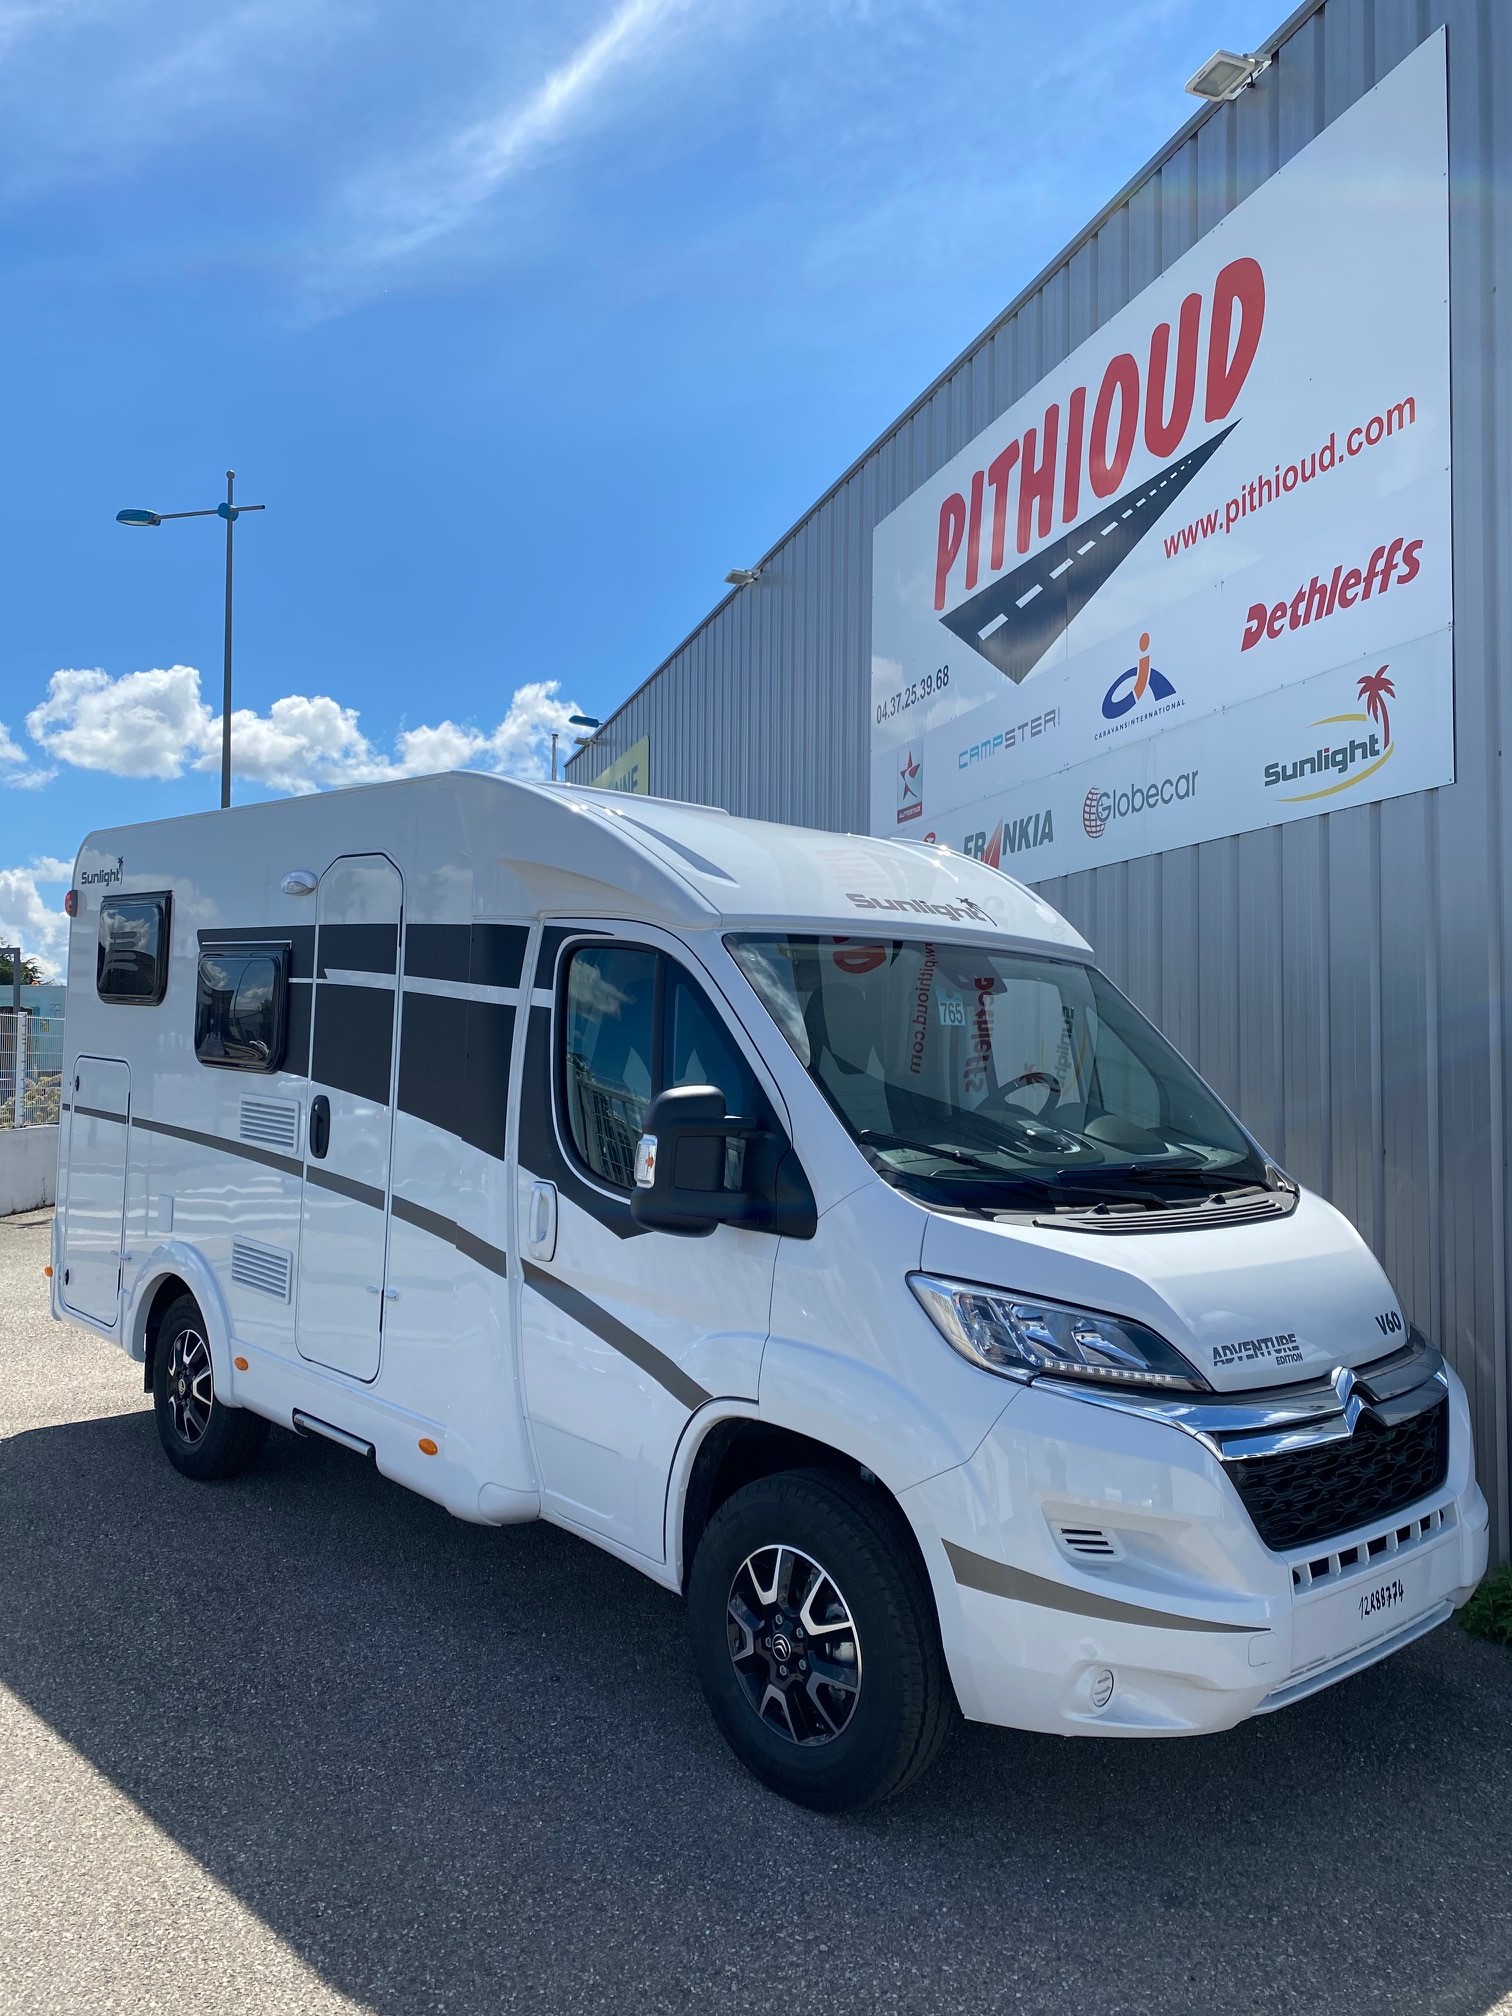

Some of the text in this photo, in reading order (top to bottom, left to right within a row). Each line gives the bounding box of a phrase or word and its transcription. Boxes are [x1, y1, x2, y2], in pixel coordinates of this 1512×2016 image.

[934, 257, 1266, 611] PITHIOUD
[1163, 397, 1417, 559] www.pithioud.com
[1241, 537, 1424, 652] Dethleffs
[875, 665, 950, 725] 04.37.25.39.68
[1264, 733, 1380, 787] Sunlight
[1097, 768, 1199, 823] Globecar
[963, 810, 1054, 869] FRANKIA
[81, 867, 121, 886] Sunlight
[845, 892, 986, 924] Sunlight
[940, 1002, 964, 1024] 765
[1375, 1310, 1402, 1335] V60
[1213, 1333, 1300, 1367] ADVENTURE
[1275, 1352, 1304, 1366] EDITION
